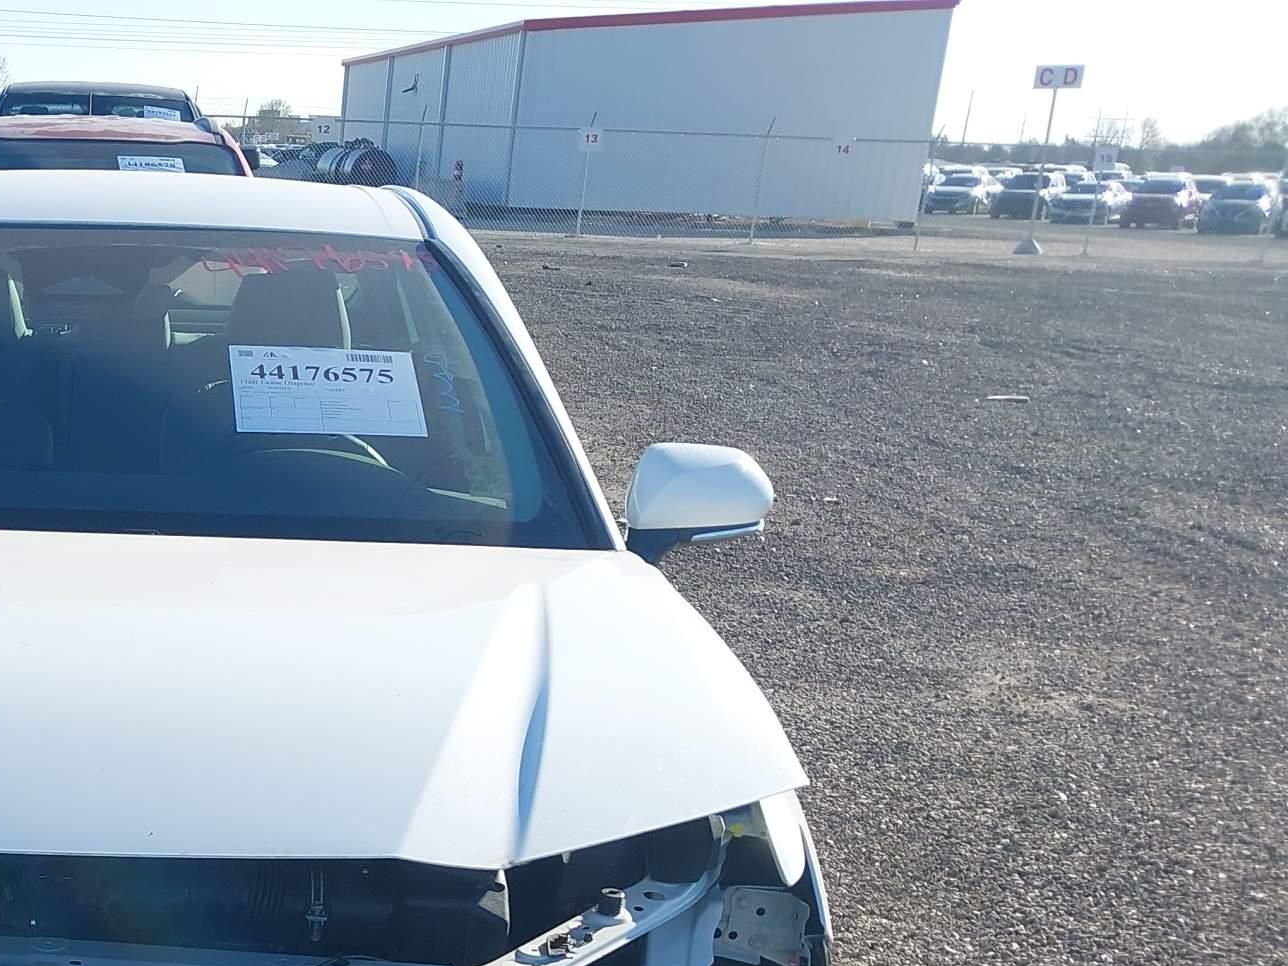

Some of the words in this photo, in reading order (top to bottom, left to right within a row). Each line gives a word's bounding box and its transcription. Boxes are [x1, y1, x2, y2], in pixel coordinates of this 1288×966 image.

[1039, 67, 1055, 87] C
[1063, 67, 1079, 86] D
[317, 125, 331, 135] 12
[584, 133, 599, 144] 13
[836, 144, 850, 155] 14
[250, 363, 394, 385] 44176575
